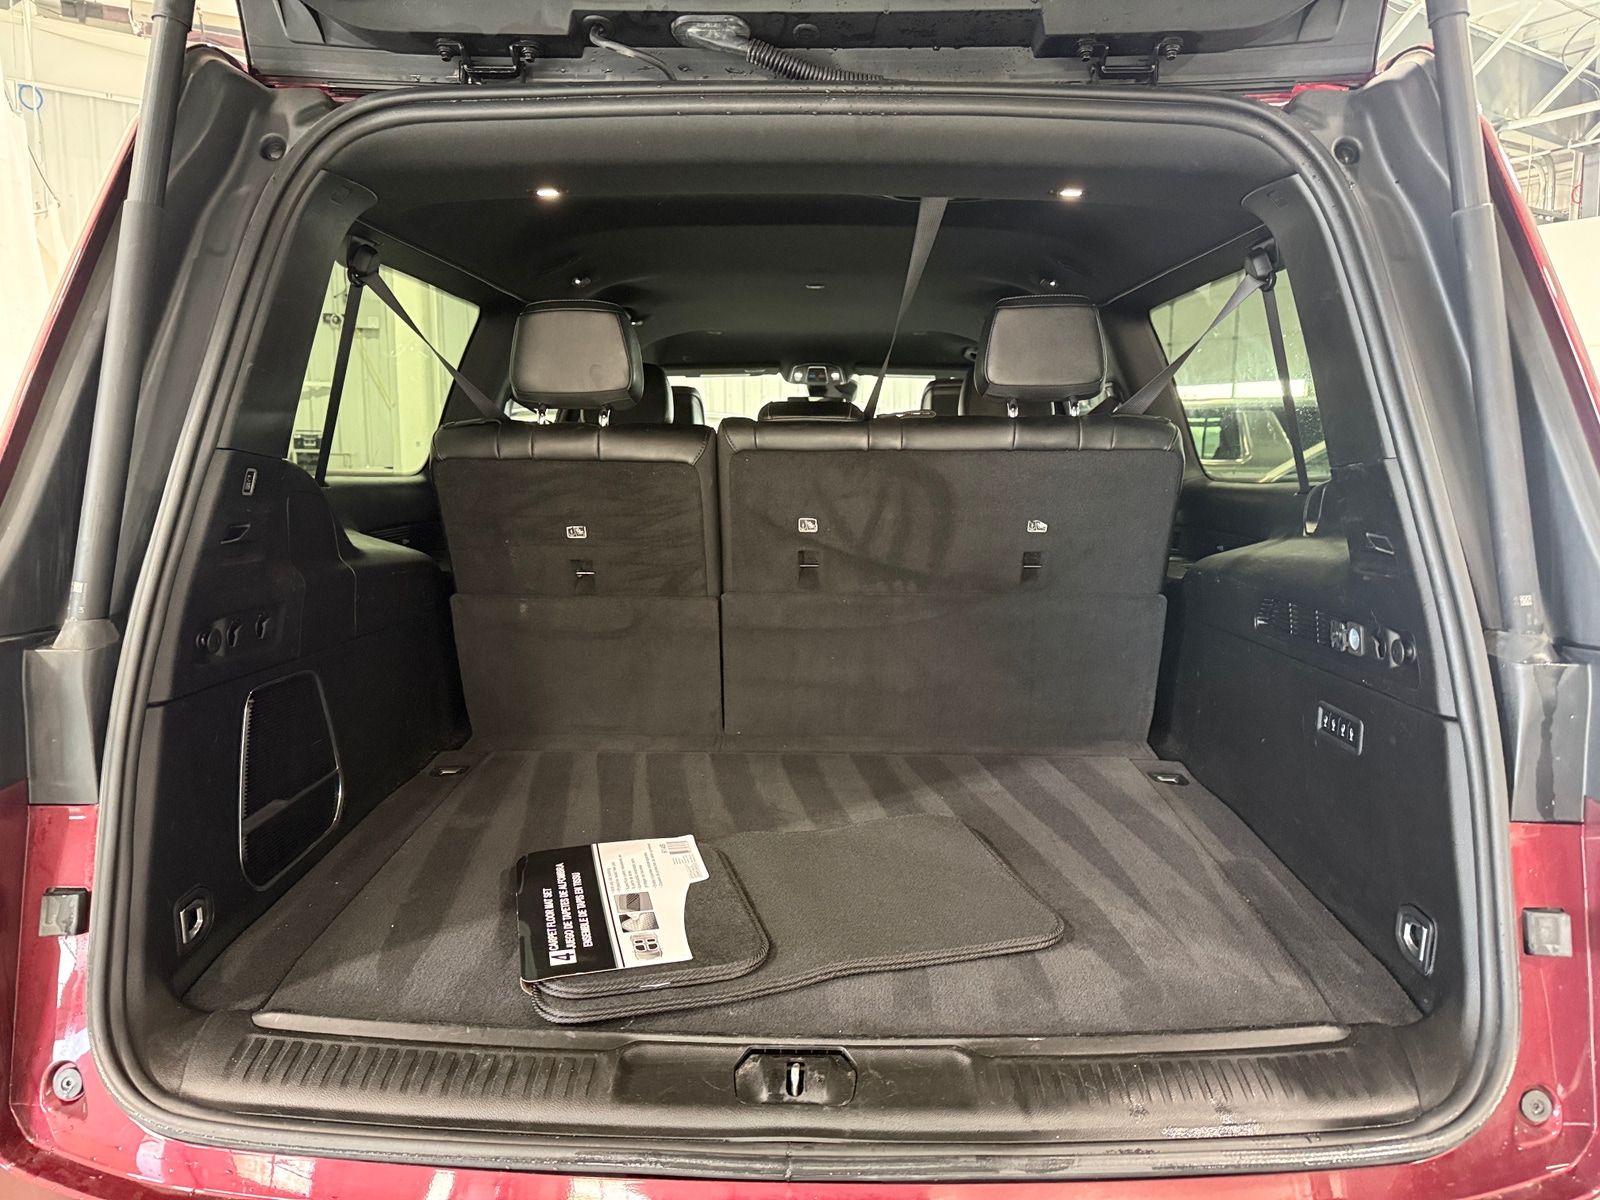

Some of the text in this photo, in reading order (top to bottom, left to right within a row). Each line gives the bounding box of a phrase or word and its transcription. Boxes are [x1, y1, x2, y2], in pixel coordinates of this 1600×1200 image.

[543, 888, 559, 950] CARPET FLOOR MAT SET
[555, 862, 576, 949] JUEGO DE TAPETES DE ALFOMBRA
[571, 872, 593, 947] ENSEMBLE DE TAPIS EN TISSU
